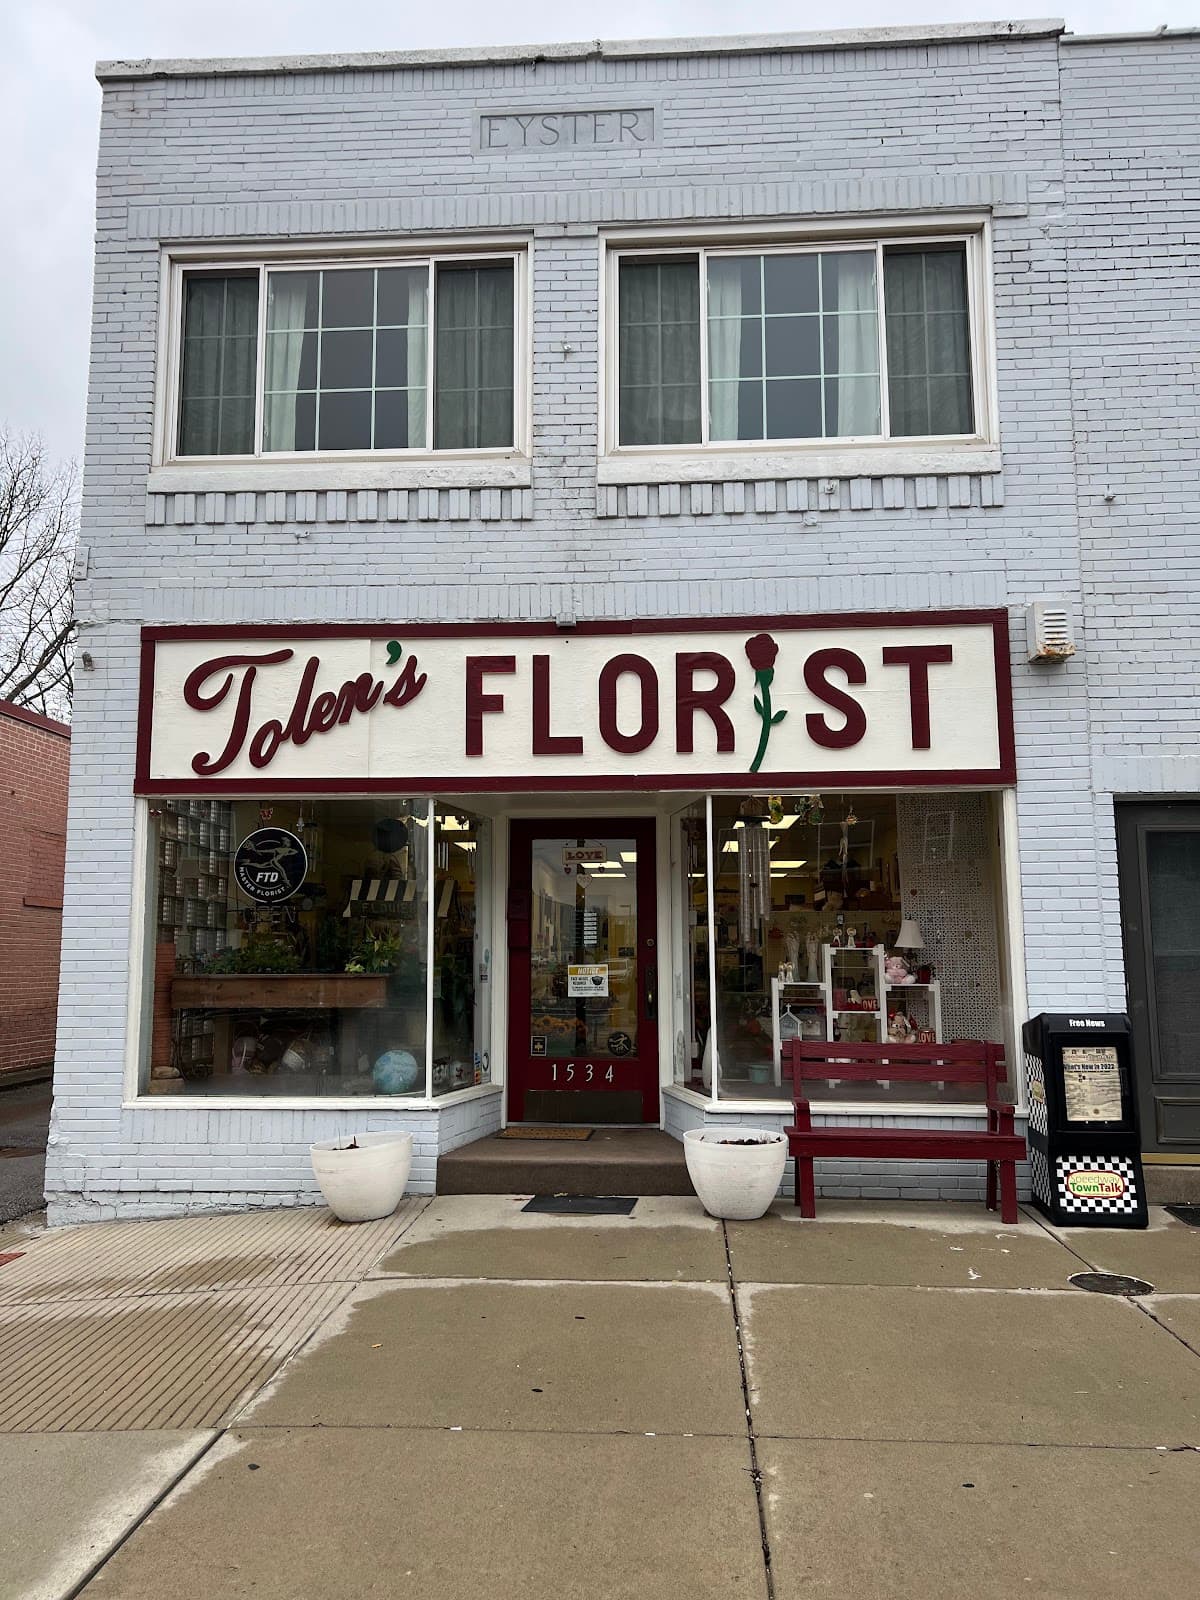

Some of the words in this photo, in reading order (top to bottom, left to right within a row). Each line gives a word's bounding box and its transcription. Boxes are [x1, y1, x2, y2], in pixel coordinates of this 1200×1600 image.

[487, 111, 647, 148] EYSTER
[184, 640, 427, 775] Tolen's
[567, 851, 602, 859] LOVE
[239, 866, 255, 891] MASTER
[255, 872, 279, 882] FTD
[1069, 1019, 1085, 1027] Free
[1085, 1019, 1105, 1027] News
[551, 1063, 614, 1083] 1534
[1070, 1175, 1120, 1184] Speedway
[1070, 1182, 1122, 1193] TownTalk
